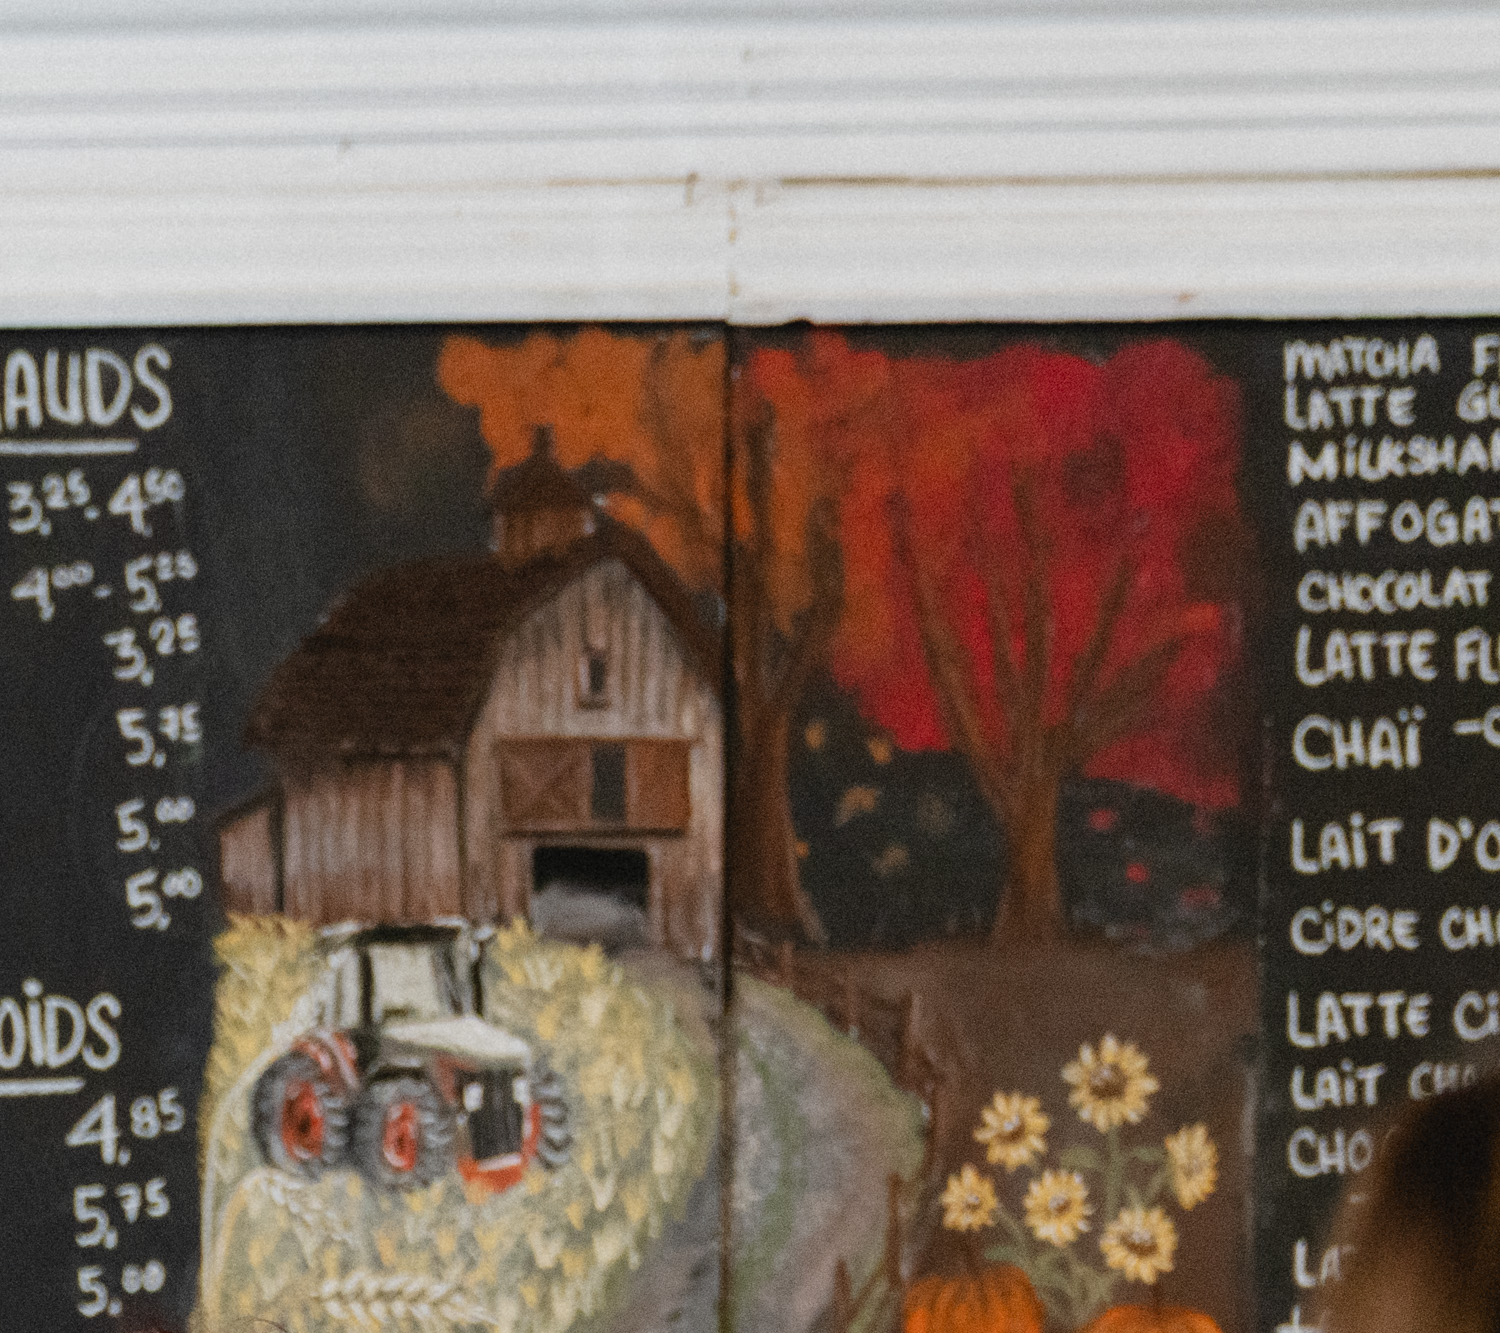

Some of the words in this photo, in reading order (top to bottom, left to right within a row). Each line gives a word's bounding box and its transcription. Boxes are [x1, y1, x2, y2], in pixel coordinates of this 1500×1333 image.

[1284, 332, 1440, 381] MATCHA
[1286, 384, 1416, 431] LATTE
[1298, 568, 1492, 613] CHOCOLAT
[1296, 626, 1438, 686] LATTE
[1292, 812, 1402, 875] LAIT
[1291, 900, 1420, 955] CIDRE
[1288, 988, 1430, 1049] LATTE
[1291, 1059, 1385, 1110] LAIT
[1408, 1061, 1480, 1100] CHA
